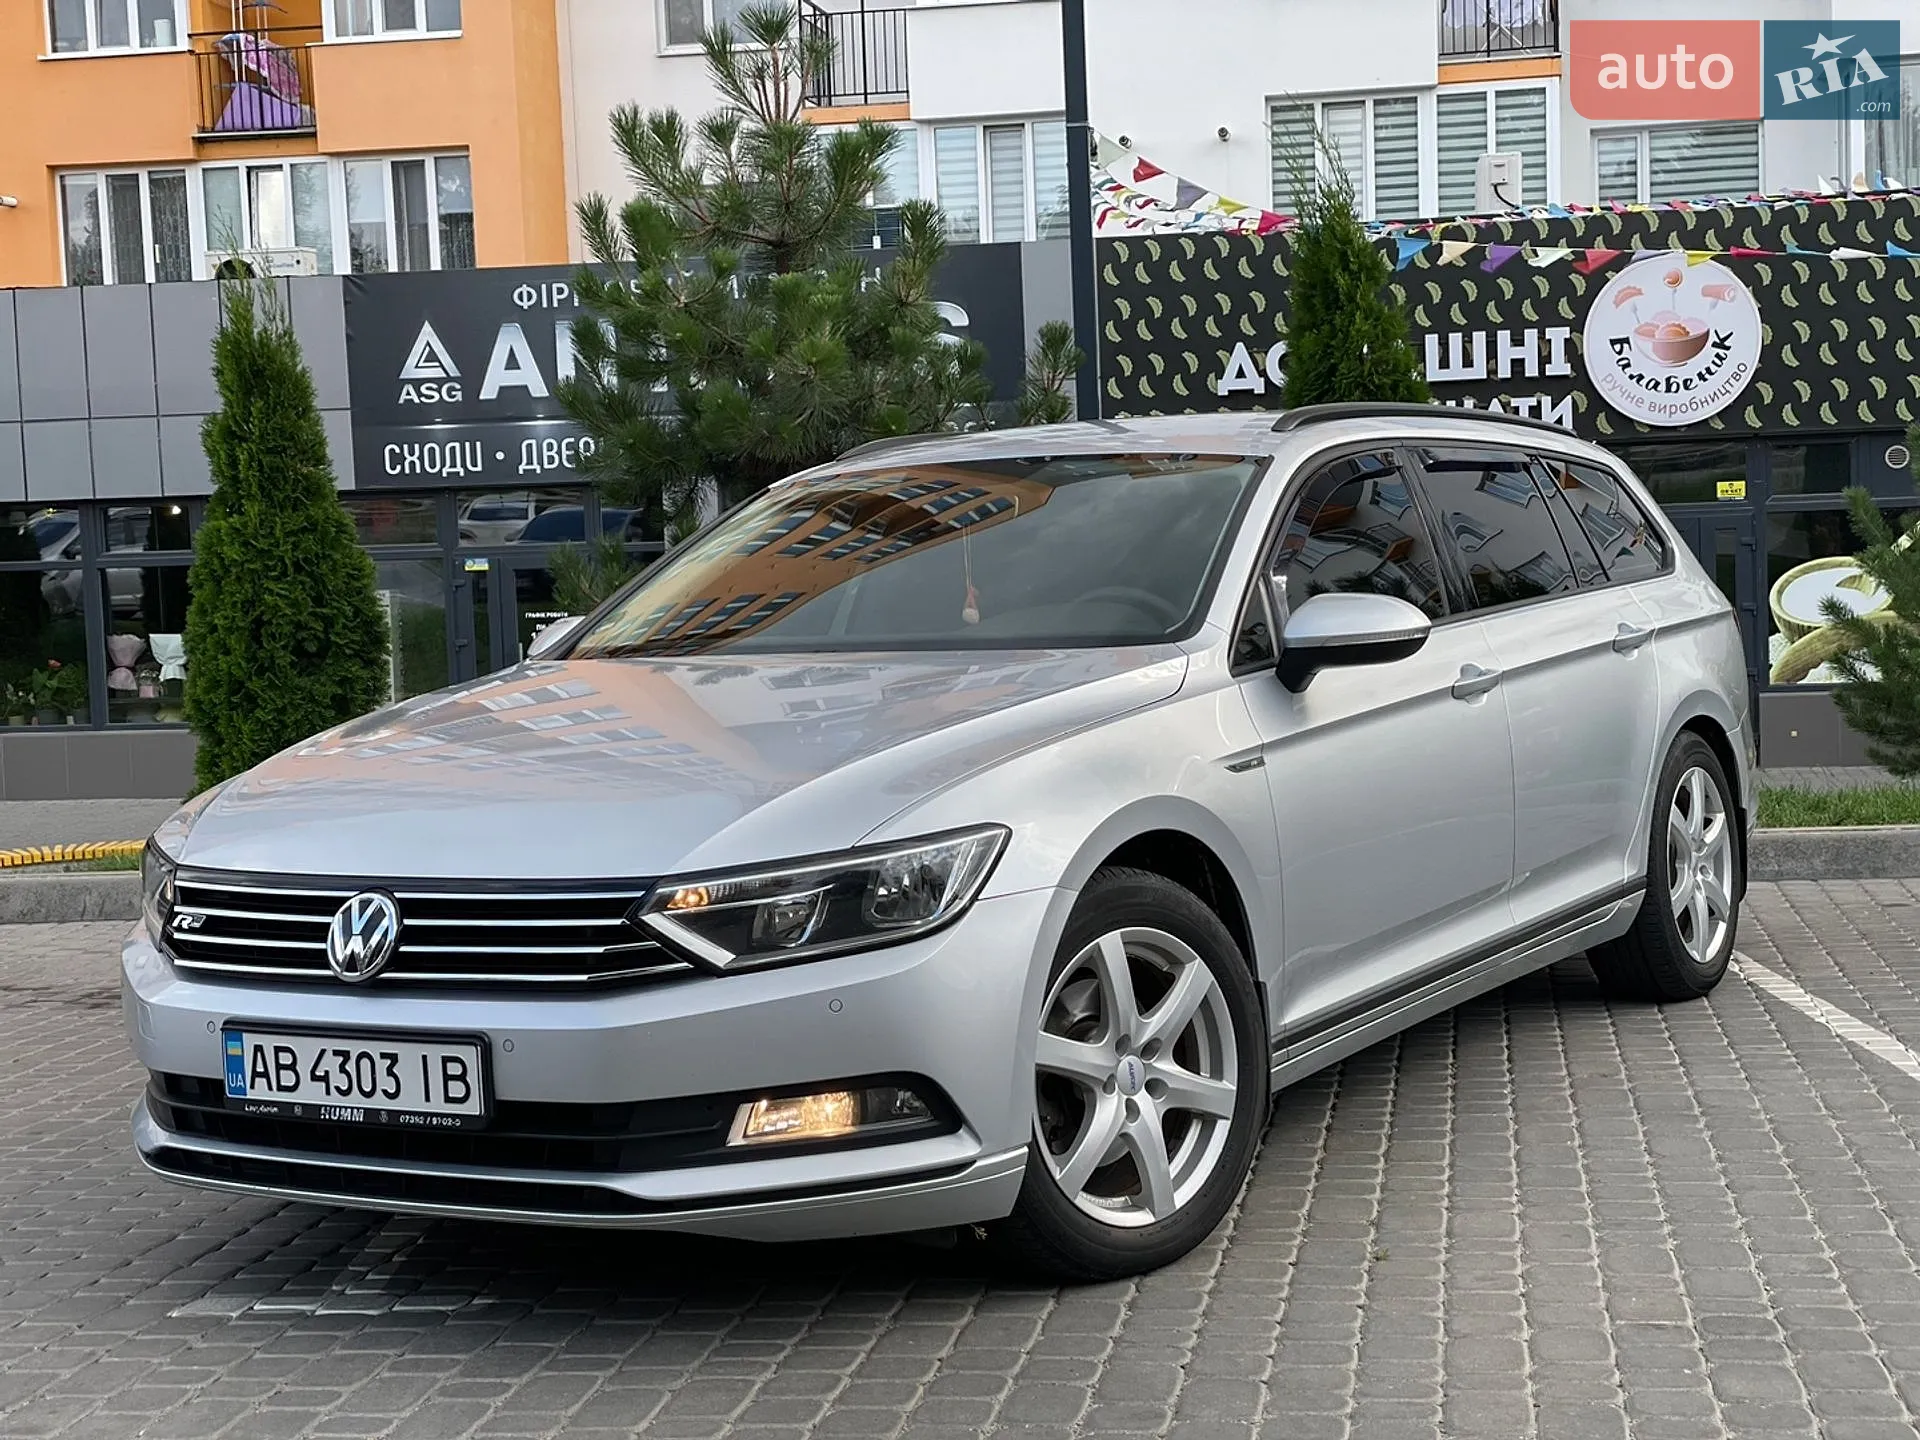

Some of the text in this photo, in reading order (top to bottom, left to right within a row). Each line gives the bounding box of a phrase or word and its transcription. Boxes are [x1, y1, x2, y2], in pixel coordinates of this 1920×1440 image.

[398, 381, 463, 404] ASG
[1601, 362, 1748, 418] ручне виробництво
[384, 436, 604, 477] СХОДИ ДВЕР
[229, 1043, 471, 1104] UA AB 4303 IB
